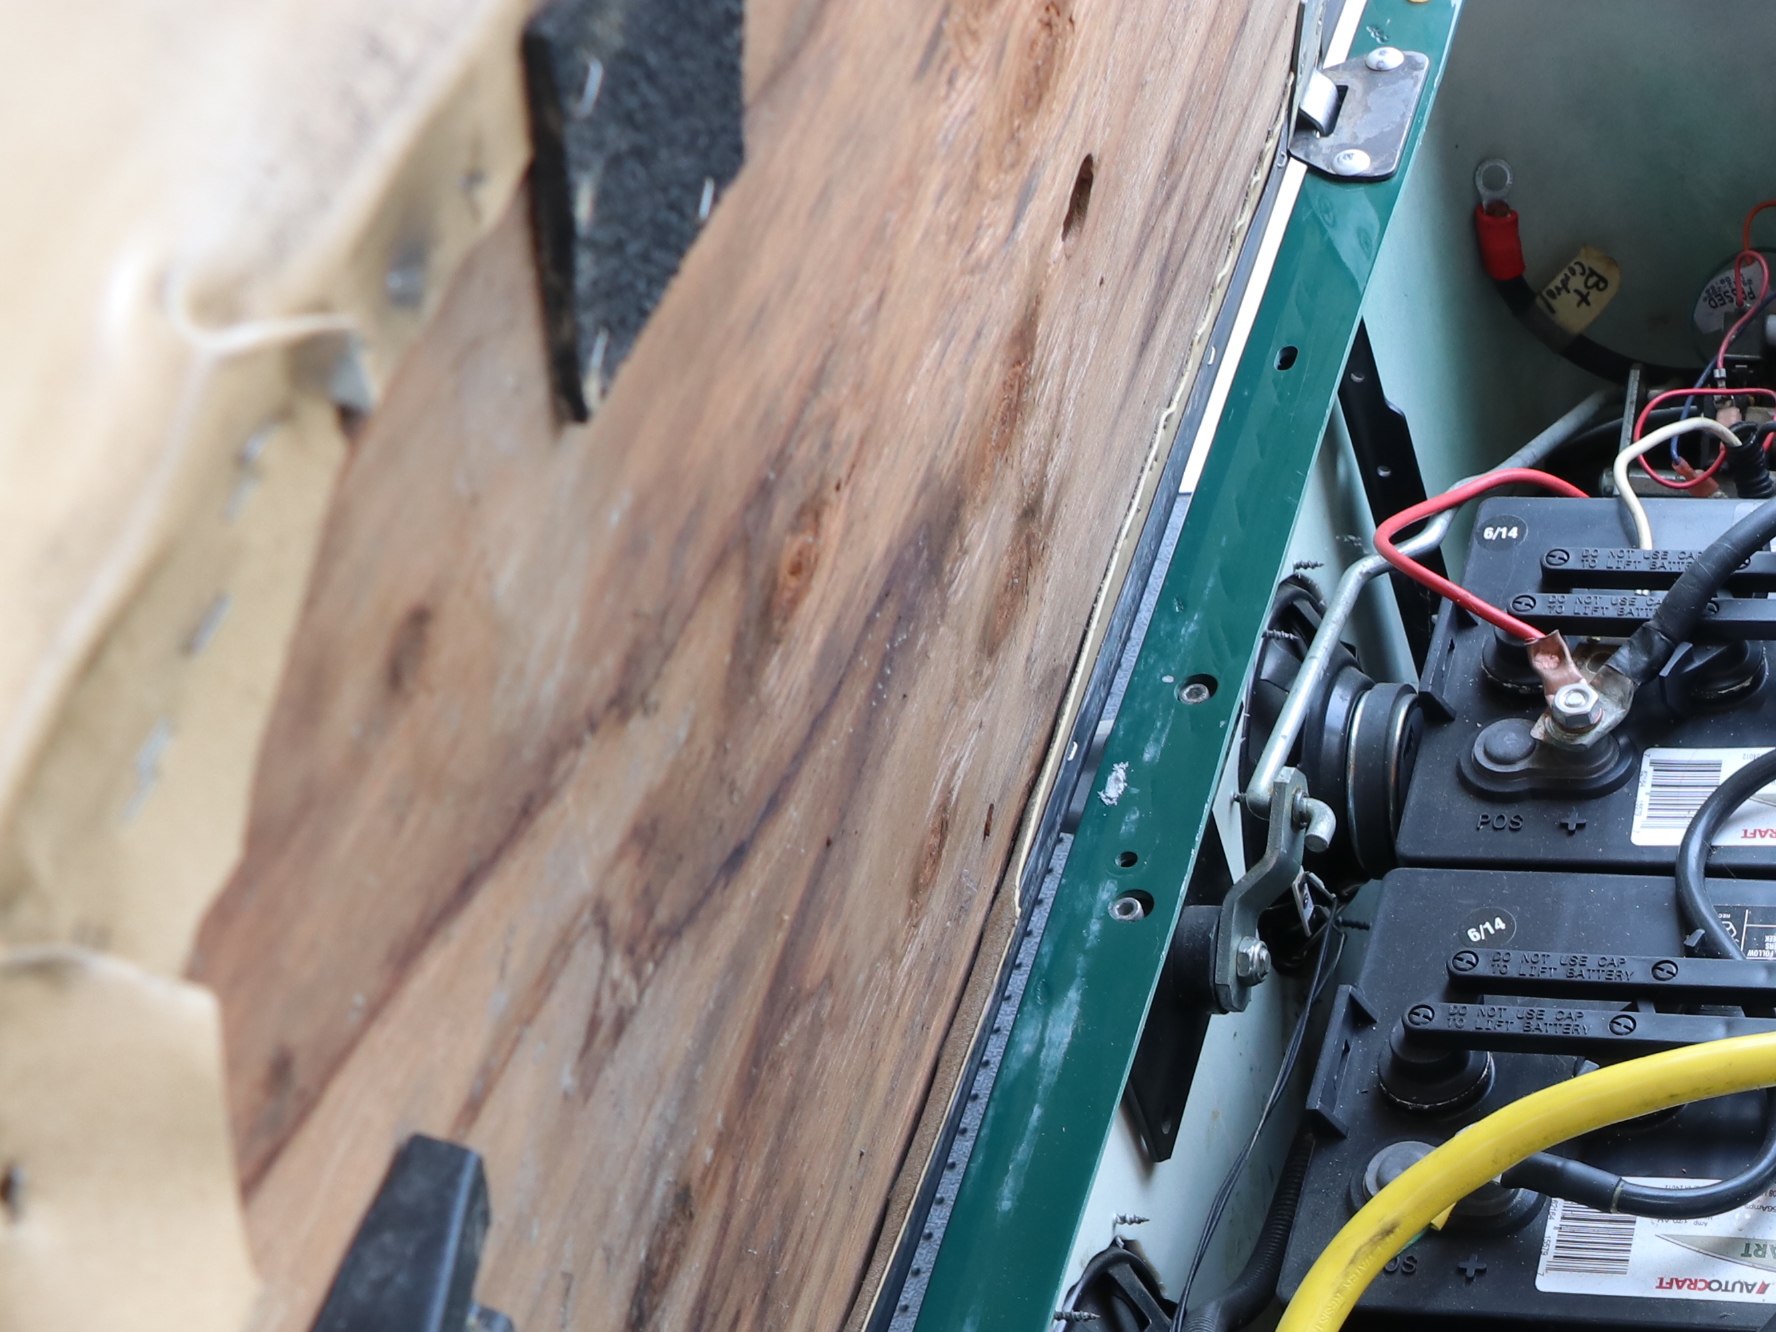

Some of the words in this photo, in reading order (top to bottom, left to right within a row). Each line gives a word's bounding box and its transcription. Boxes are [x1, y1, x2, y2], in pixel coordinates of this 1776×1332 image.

[1483, 527, 1518, 540] 6/14
[1476, 813, 1523, 831] POS
[1467, 917, 1506, 942] 6/14
